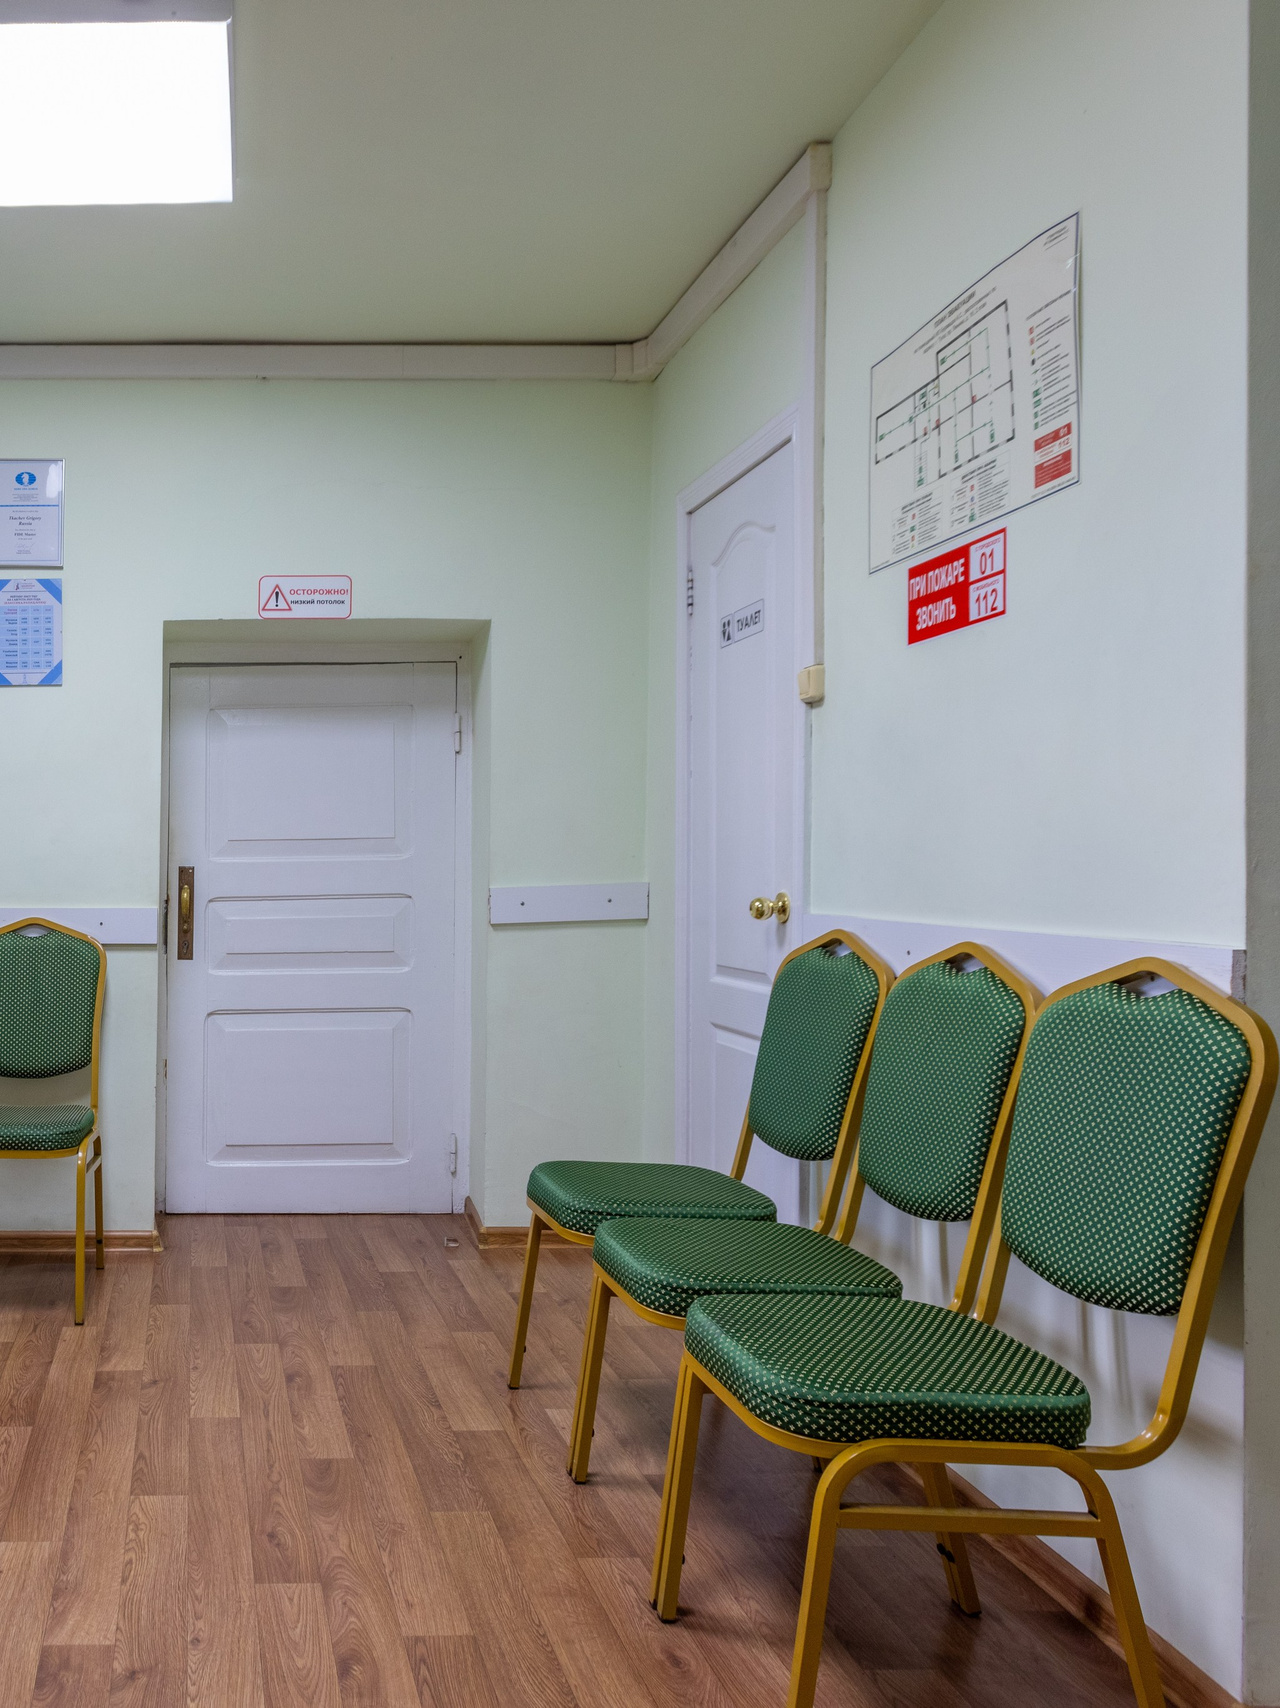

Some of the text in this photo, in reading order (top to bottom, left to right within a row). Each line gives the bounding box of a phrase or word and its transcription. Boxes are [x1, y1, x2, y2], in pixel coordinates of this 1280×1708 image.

[980, 547, 994, 575] 01
[289, 588, 349, 596] ОСТОРОЖНО!
[909, 558, 965, 602] ПРИ ПОЖАРЕ
[916, 596, 956, 631] ЗВОНИТЬ
[975, 587, 998, 616] 112
[736, 609, 761, 632] ТУАЛЕТ
